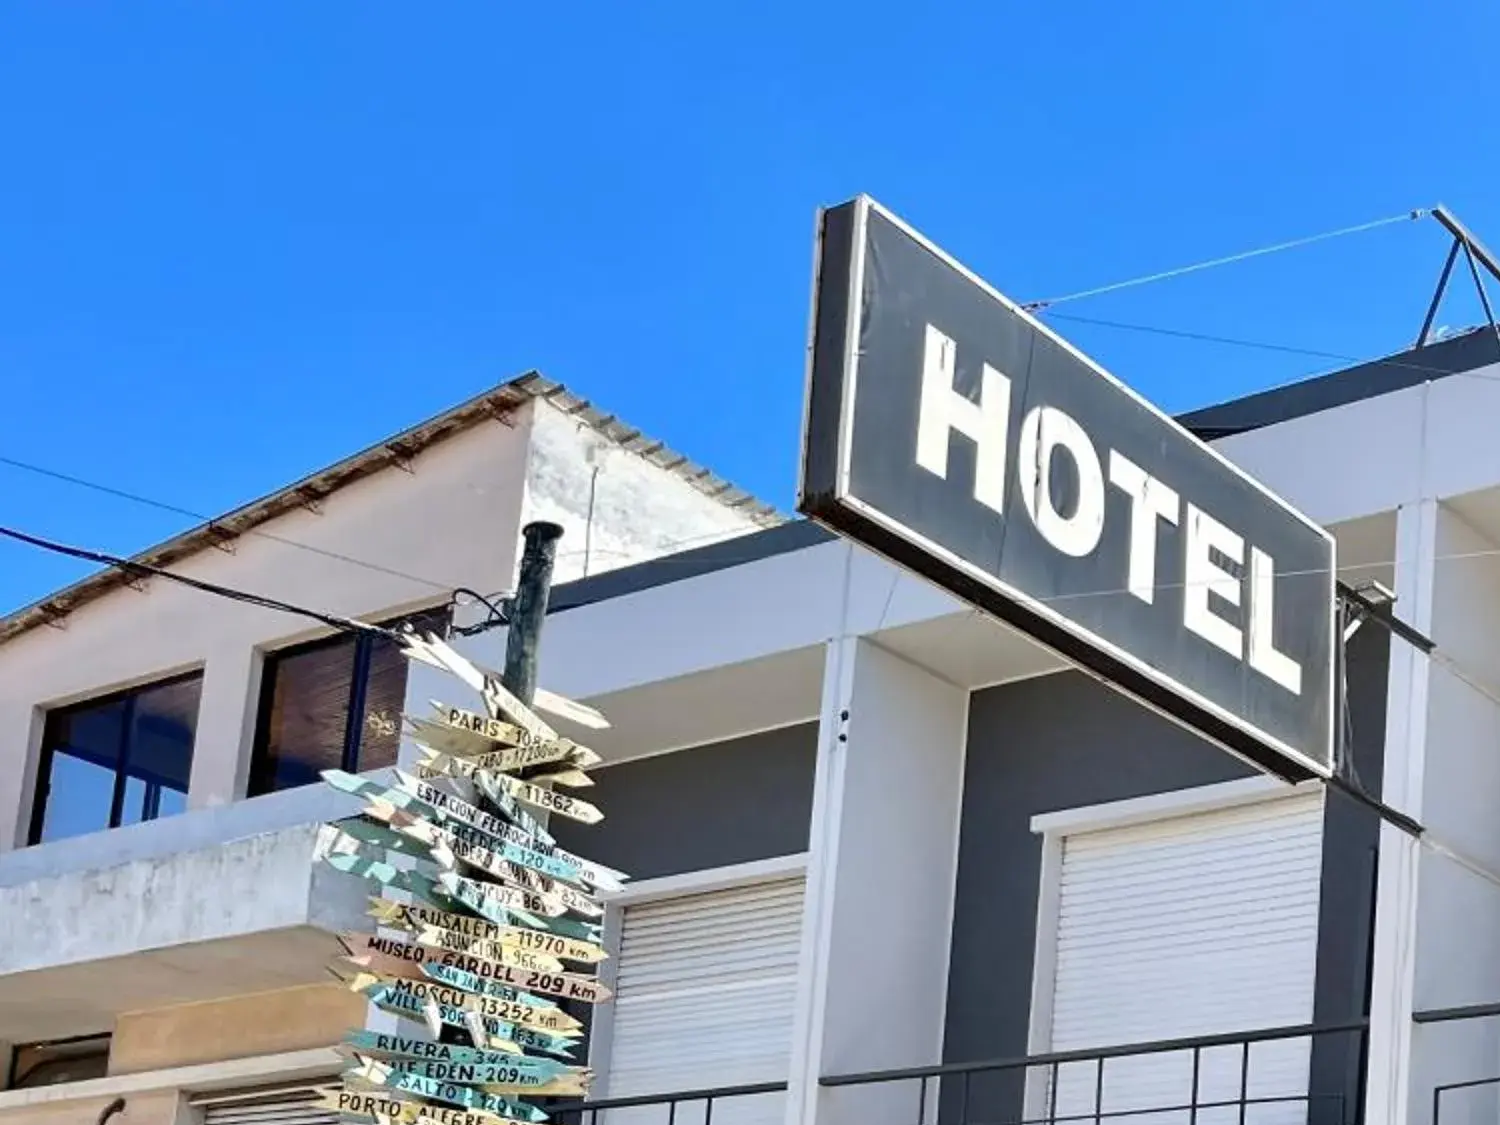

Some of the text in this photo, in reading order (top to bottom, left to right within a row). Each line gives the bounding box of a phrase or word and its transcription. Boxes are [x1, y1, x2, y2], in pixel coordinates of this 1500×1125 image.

[915, 322, 1301, 697] HOTEL
[449, 708, 500, 737] PARIS
[416, 782, 477, 822] ESTACION
[519, 848, 545, 869] 120
[435, 929, 503, 963] ASUNCION
[512, 950, 538, 968] 966
[517, 930, 565, 955] 11970
[568, 947, 589, 960] km
[367, 937, 597, 999] MUSEO GARDEL 209 km
[384, 989, 424, 1012] VILL
[439, 1006, 499, 1035] SORNO
[395, 979, 465, 1008] MOSCU
[479, 998, 533, 1022] 13252
[377, 1035, 451, 1060] RIVERA
[399, 1074, 457, 1100] SALTO
[425, 1063, 475, 1081] EDEN
[338, 1093, 401, 1117] PORTO
